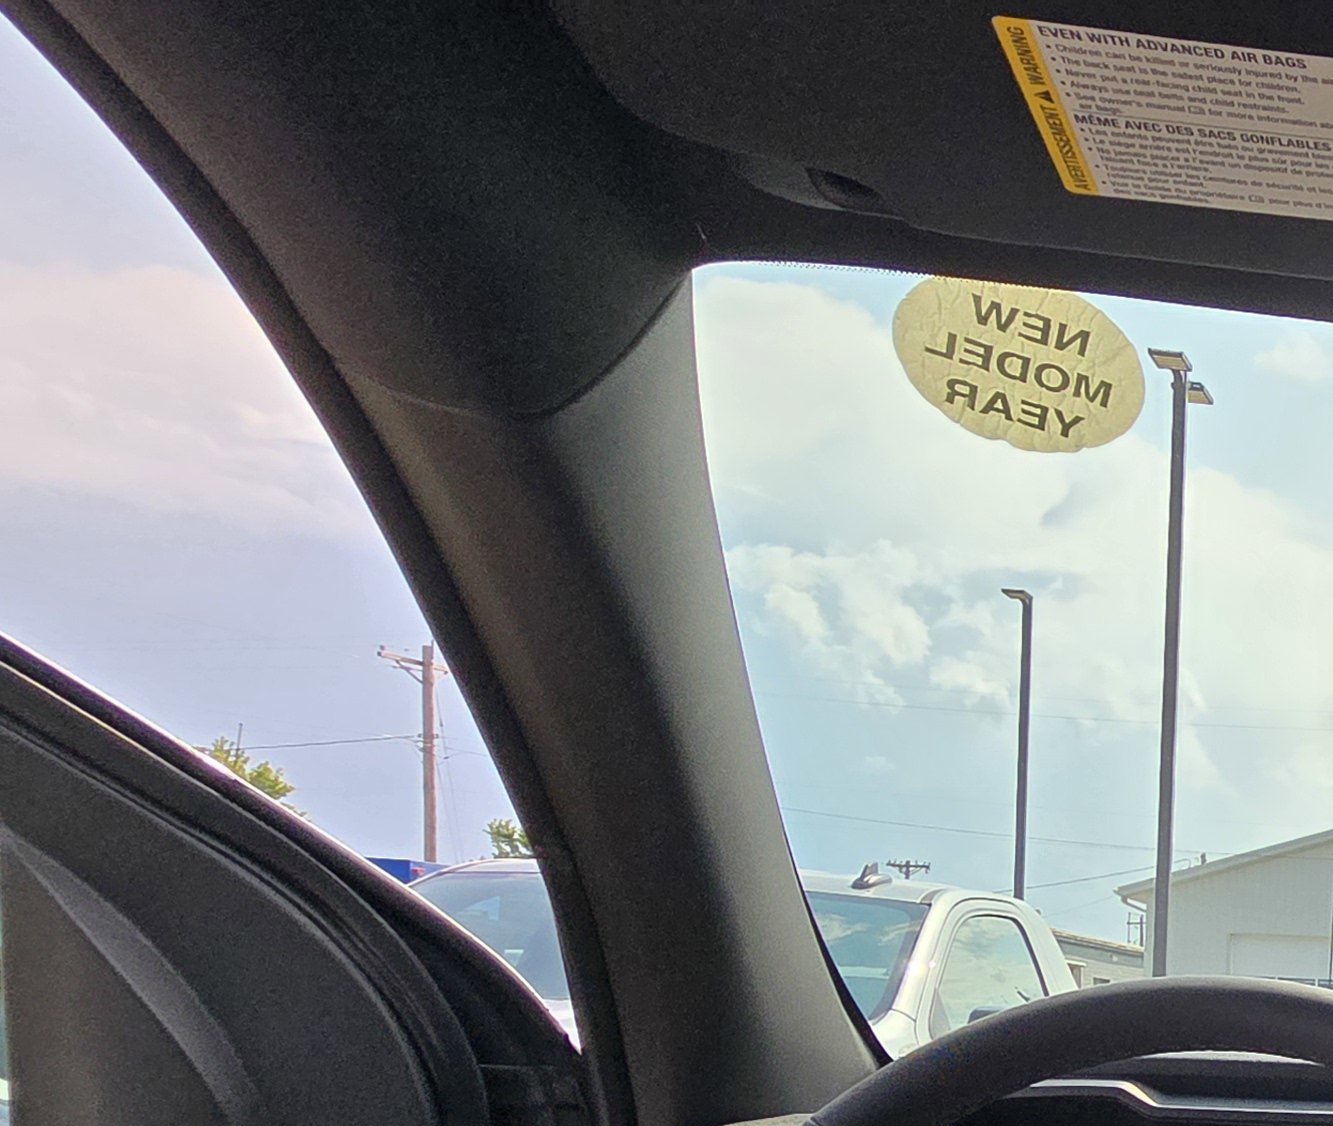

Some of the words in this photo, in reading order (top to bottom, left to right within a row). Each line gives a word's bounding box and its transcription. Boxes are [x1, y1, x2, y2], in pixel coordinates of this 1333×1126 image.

[1007, 26, 1047, 85] WARNING
[1036, 25, 1082, 40] EVEN
[1084, 31, 1131, 47] WITH
[1132, 38, 1225, 59] ADVANCED
[1229, 50, 1258, 63] AIR
[1262, 54, 1307, 68] BAGS
[1040, 105, 1091, 191] AVERTISSEMENT
[1072, 113, 1121, 128] MÊME
[1122, 119, 1163, 132] AVEC
[1165, 124, 1195, 136] DES
[1197, 128, 1237, 141] SACS
[1239, 133, 1332, 151] GONFLABLES
